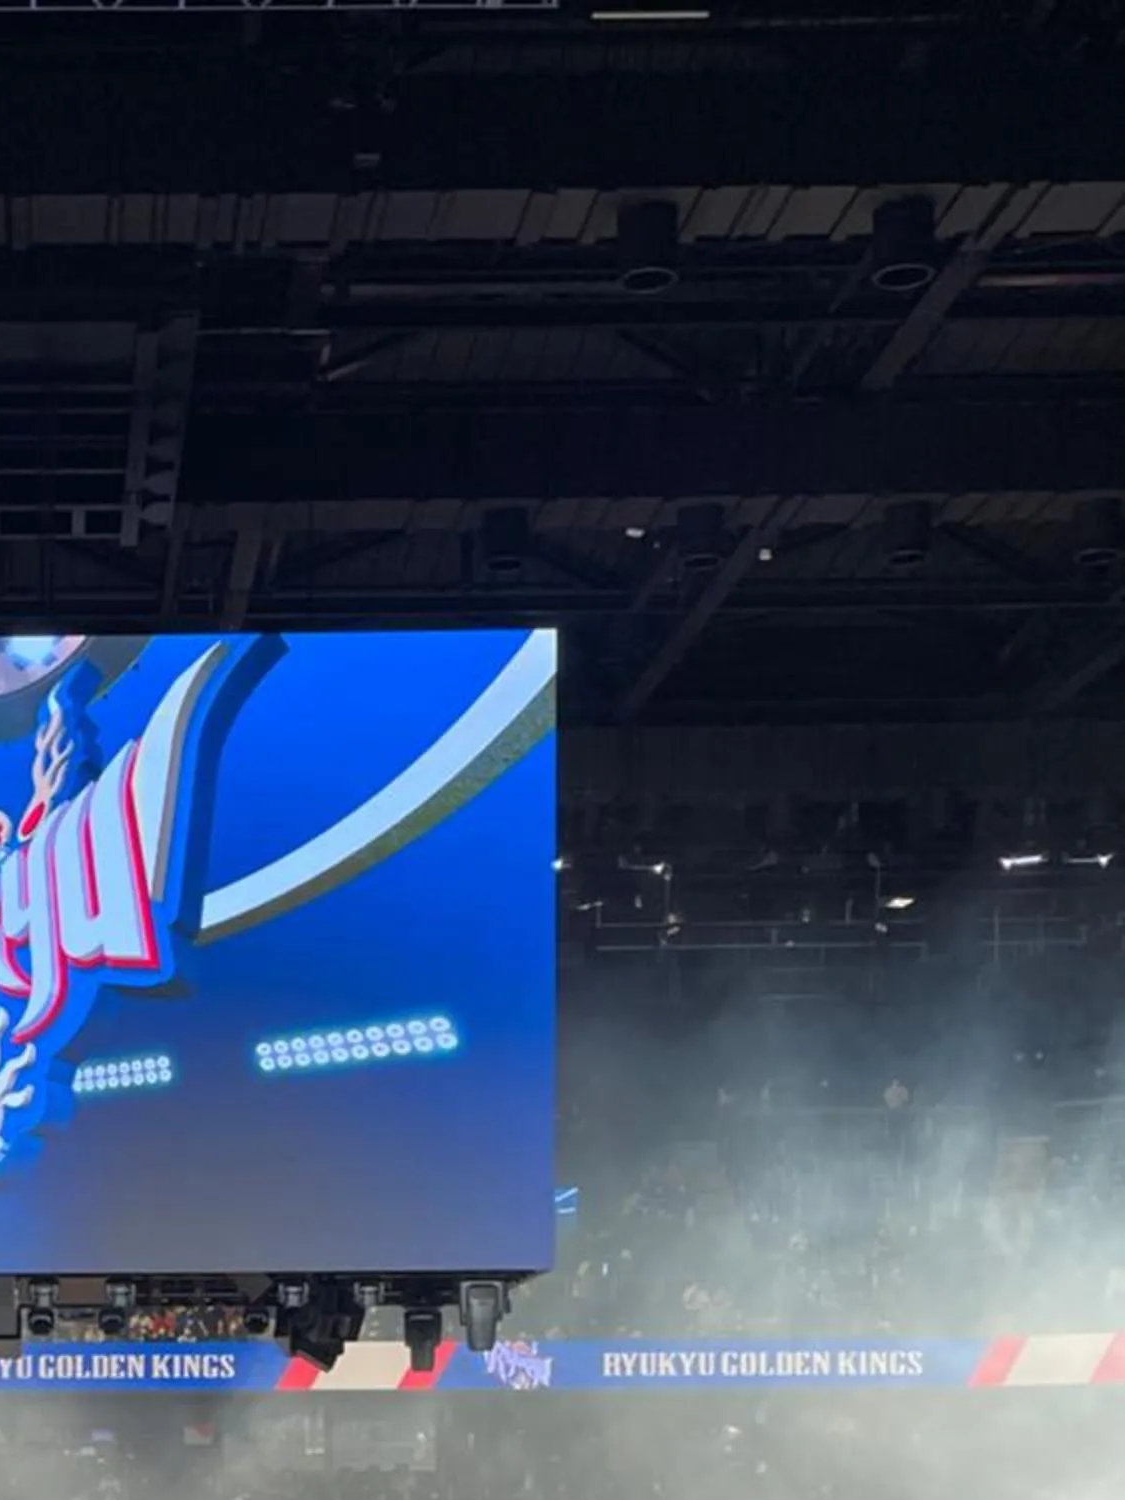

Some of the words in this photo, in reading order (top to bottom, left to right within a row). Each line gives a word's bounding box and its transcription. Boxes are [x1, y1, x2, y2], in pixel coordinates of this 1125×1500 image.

[38, 1354, 145, 1379] GOLDEN
[151, 1353, 236, 1379] KINGS
[603, 1351, 715, 1377] RYUKYU
[721, 1351, 829, 1377] GOLDEN
[838, 1350, 923, 1376] KINGS
